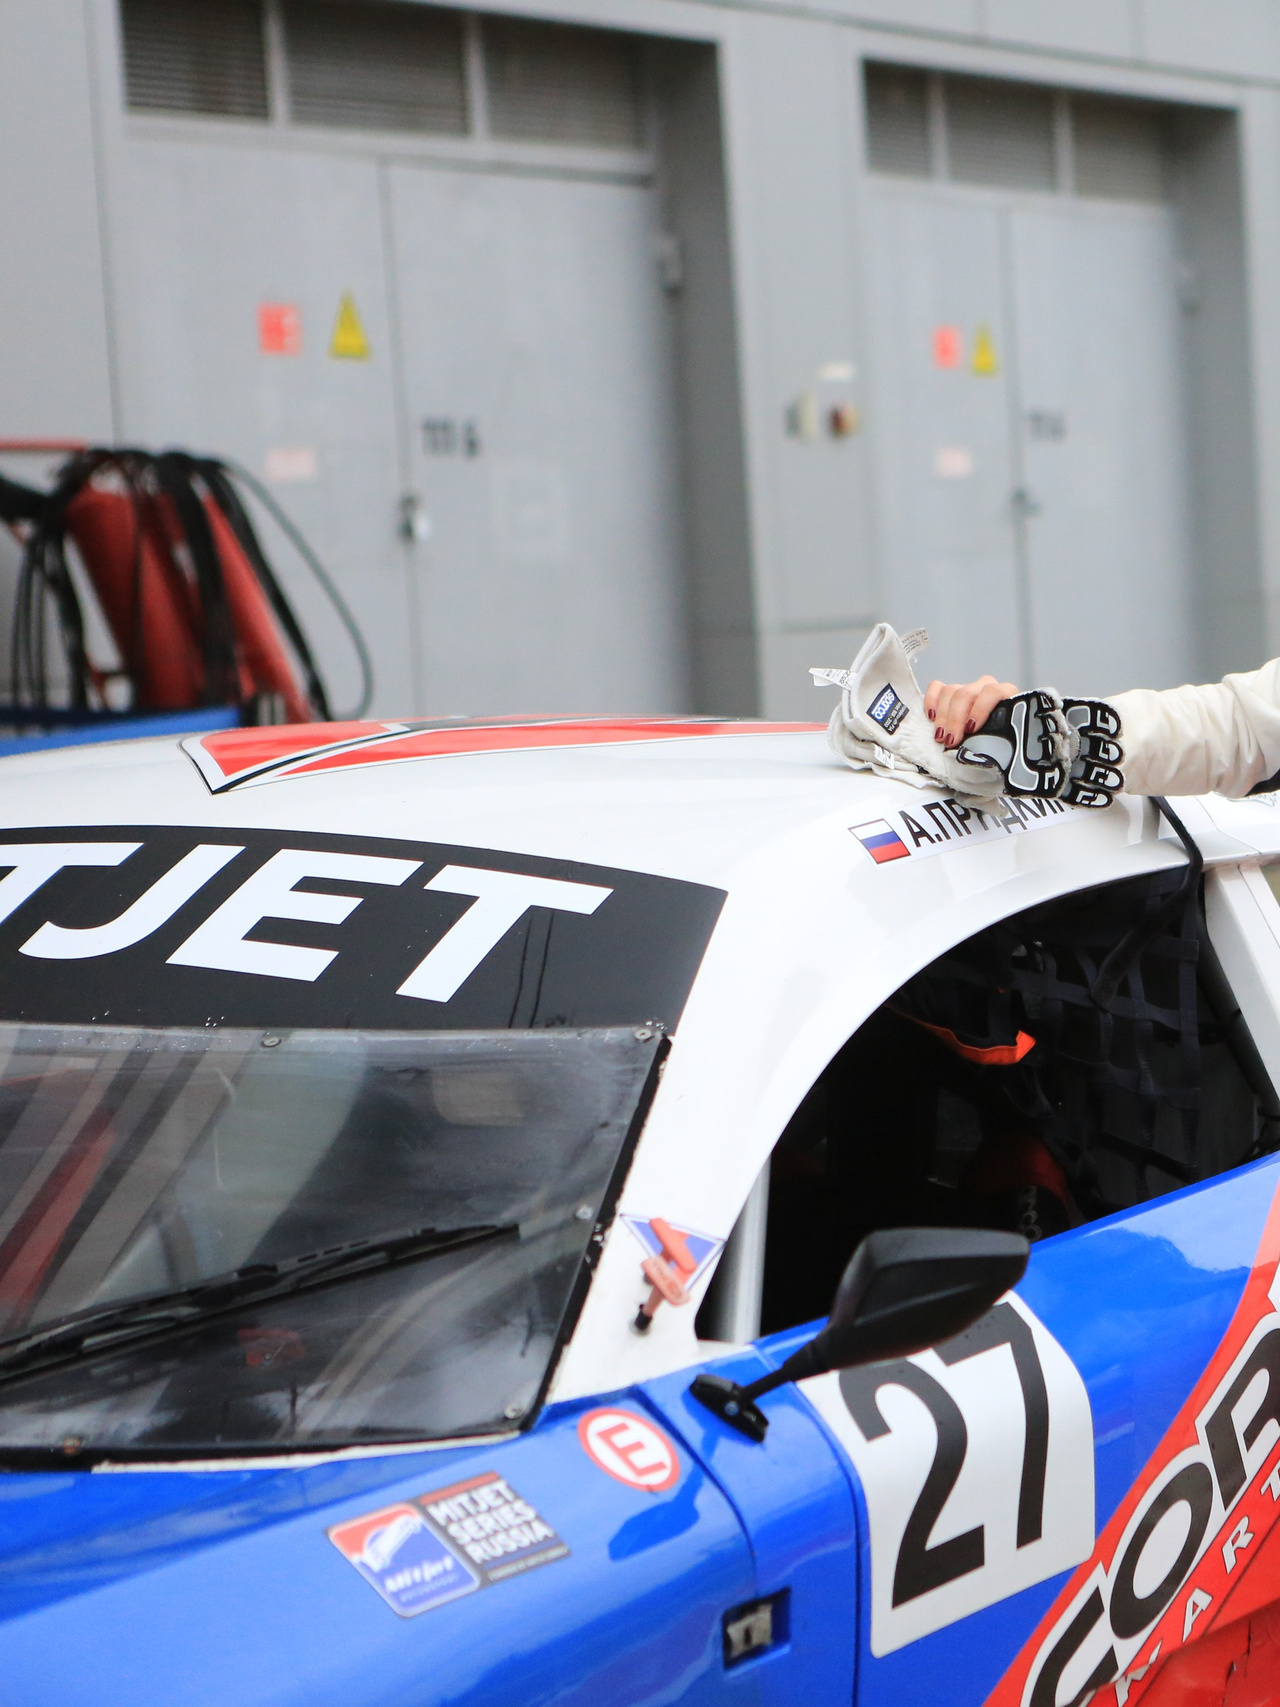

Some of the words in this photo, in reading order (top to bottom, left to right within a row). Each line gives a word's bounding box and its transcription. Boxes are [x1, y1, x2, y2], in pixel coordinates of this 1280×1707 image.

[595, 1422, 668, 1478] E
[839, 1301, 1050, 1610] 27
[426, 1479, 516, 1526] MITJET
[446, 1500, 537, 1547] SERIES
[464, 1519, 555, 1564] RUSSIA
